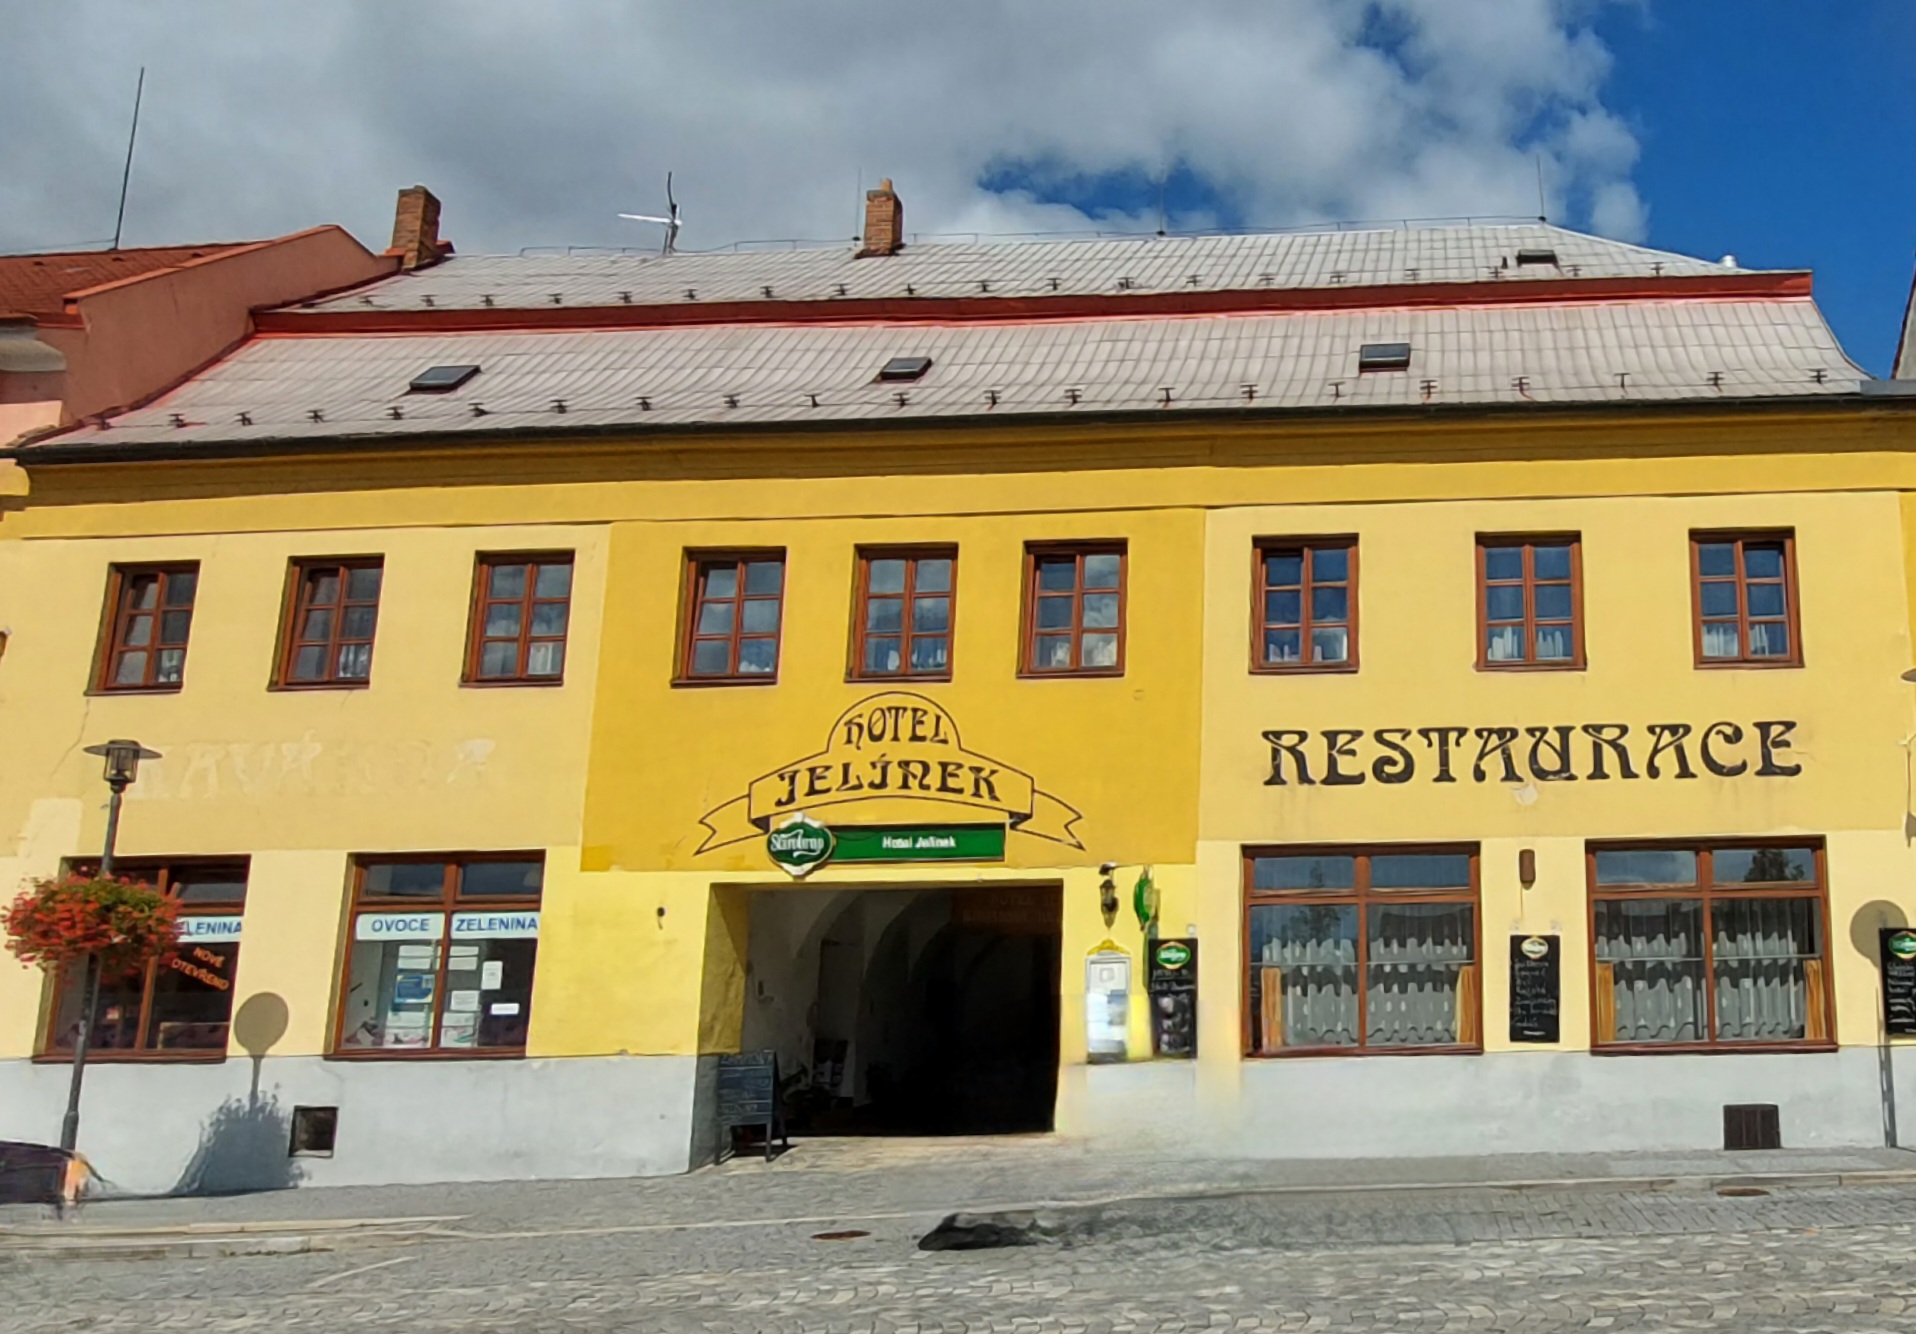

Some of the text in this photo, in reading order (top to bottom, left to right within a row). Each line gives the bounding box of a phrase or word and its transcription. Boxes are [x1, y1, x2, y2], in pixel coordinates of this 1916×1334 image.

[844, 706, 949, 750] HOTEL
[1261, 721, 1803, 786] RESTAURACE
[775, 753, 1002, 807] JELÍNEK
[372, 919, 430, 932] OVOCE
[455, 917, 537, 931] ZELENINA
